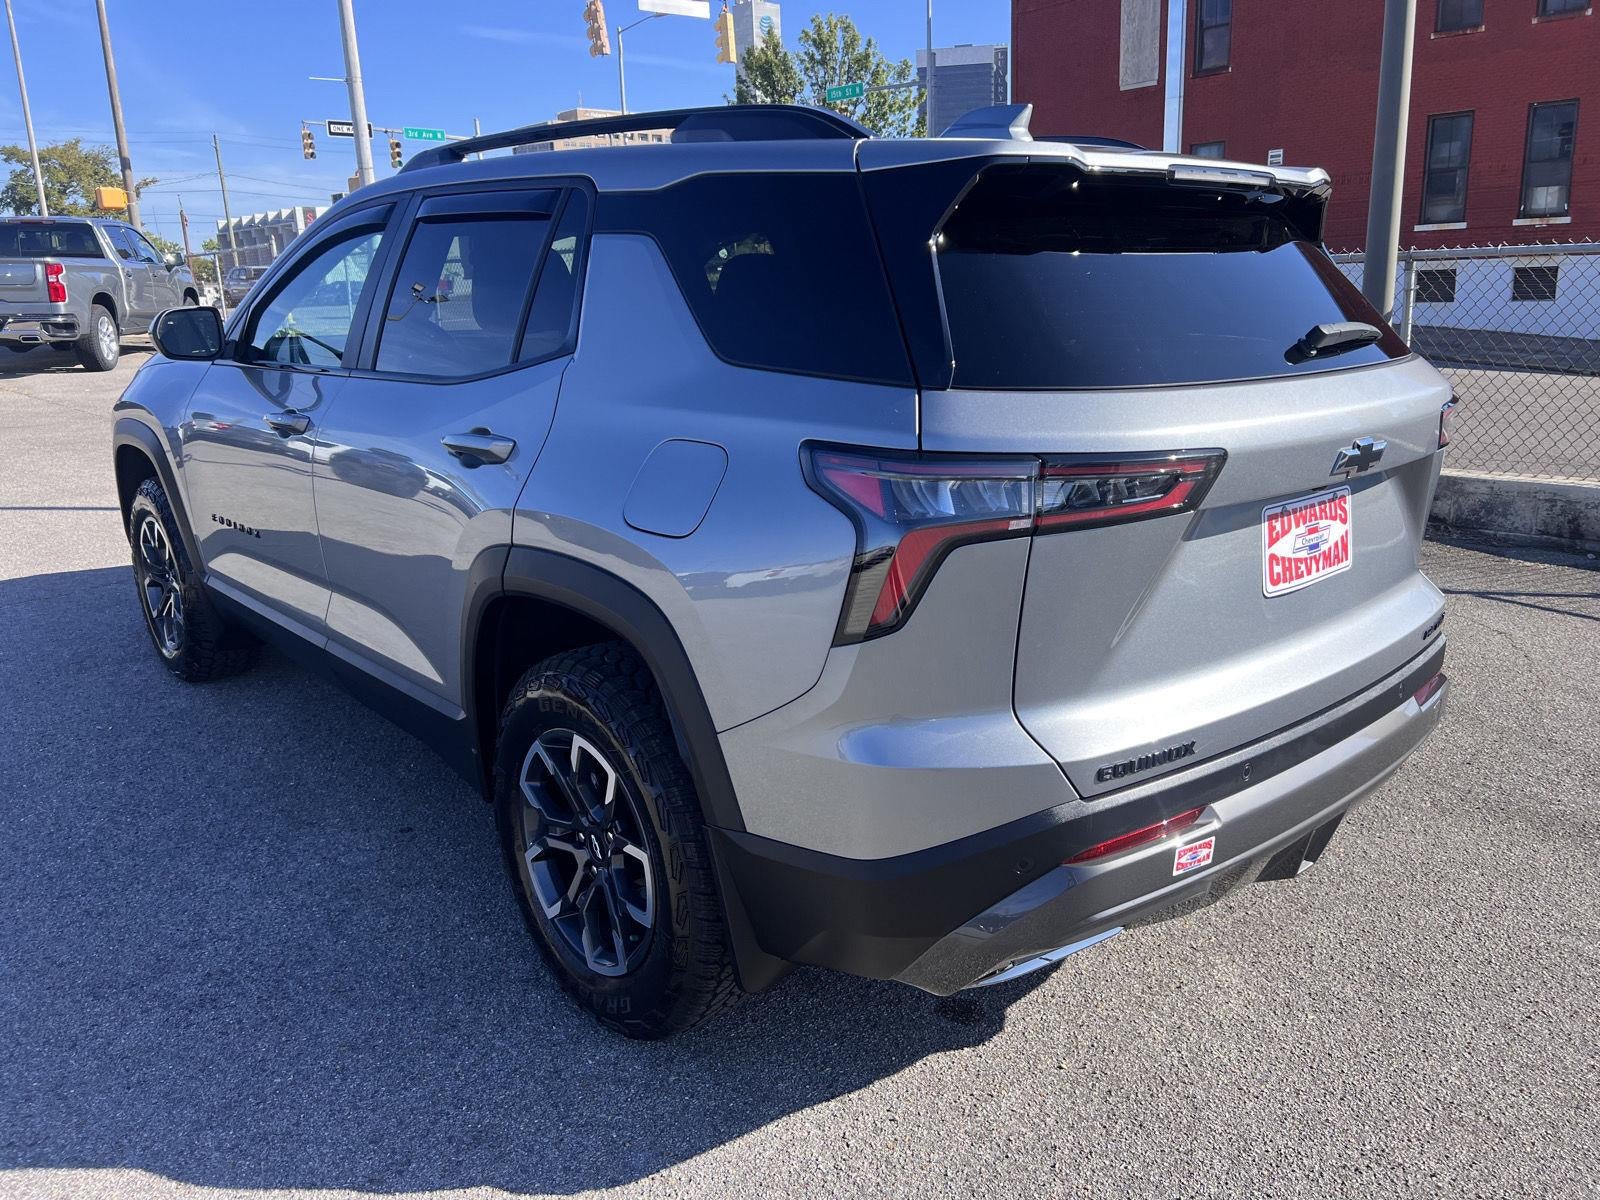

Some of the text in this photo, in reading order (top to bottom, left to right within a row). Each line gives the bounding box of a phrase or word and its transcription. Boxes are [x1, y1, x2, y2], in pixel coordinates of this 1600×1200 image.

[407, 130, 418, 138] 3rd
[422, 131, 433, 139] Ave
[1267, 495, 1348, 549] EDWARDS
[1268, 529, 1349, 587] CHEVYMAN
[1096, 740, 1196, 782] EQUINOX
[1178, 840, 1212, 861] EDWARDS
